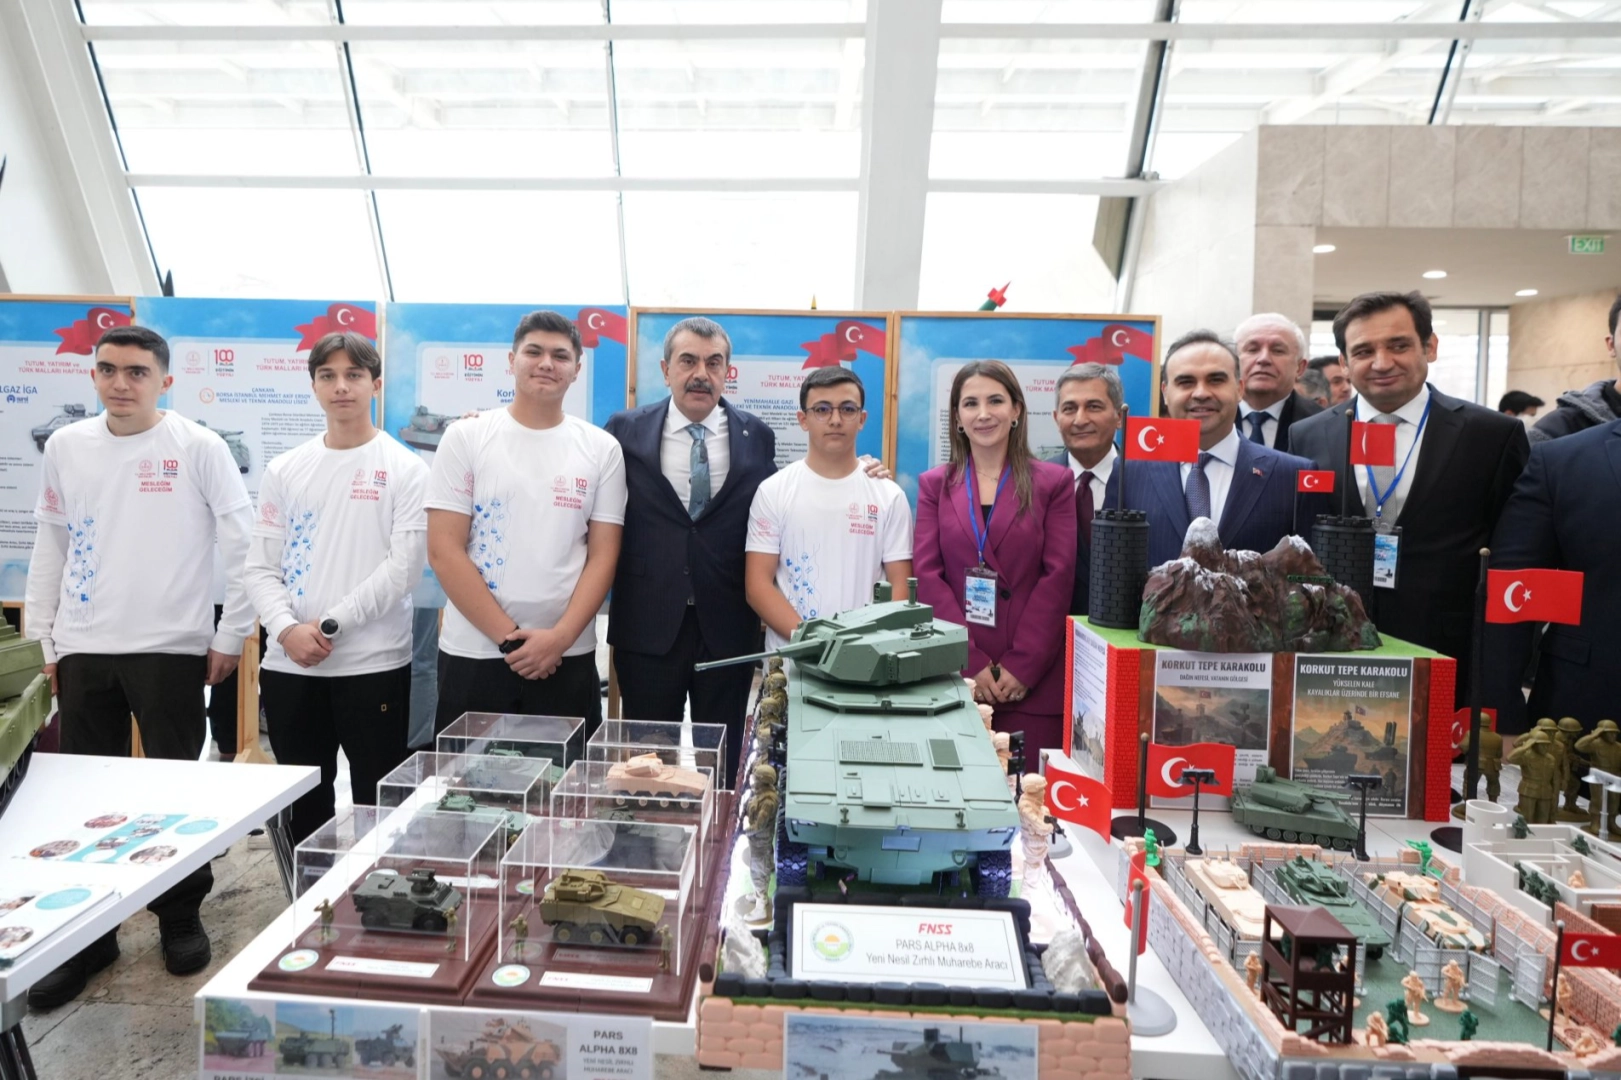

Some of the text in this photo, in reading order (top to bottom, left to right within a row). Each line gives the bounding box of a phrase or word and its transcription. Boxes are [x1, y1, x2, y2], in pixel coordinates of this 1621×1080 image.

[1574, 239, 1601, 251] EXIT
[214, 349, 234, 365] 100
[464, 354, 484, 370] 100
[0, 384, 38, 394] LGAZ İGA
[497, 390, 515, 398] Kork
[554, 502, 582, 510] GELECEĞİM
[849, 528, 875, 536] GELECEĞİM
[1162, 660, 1266, 673] KORKUT TEPE KARAKOLU
[1300, 664, 1408, 677] KORKUT TEPE KARAKOLU
[1333, 679, 1375, 688] YÜKSELEN KALE
[1307, 688, 1400, 699] KAYALIKLAR ÜZERİNDE BİR EFSANE
[918, 923, 953, 935] FNSS
[896, 939, 974, 953] PARS ALPHA 8x8
[866, 952, 1008, 970] Yeni Nesil Zırhlı Muharebe Aracı
[594, 1030, 623, 1040] PARS
[579, 1044, 638, 1056] ALPHA 8X8
